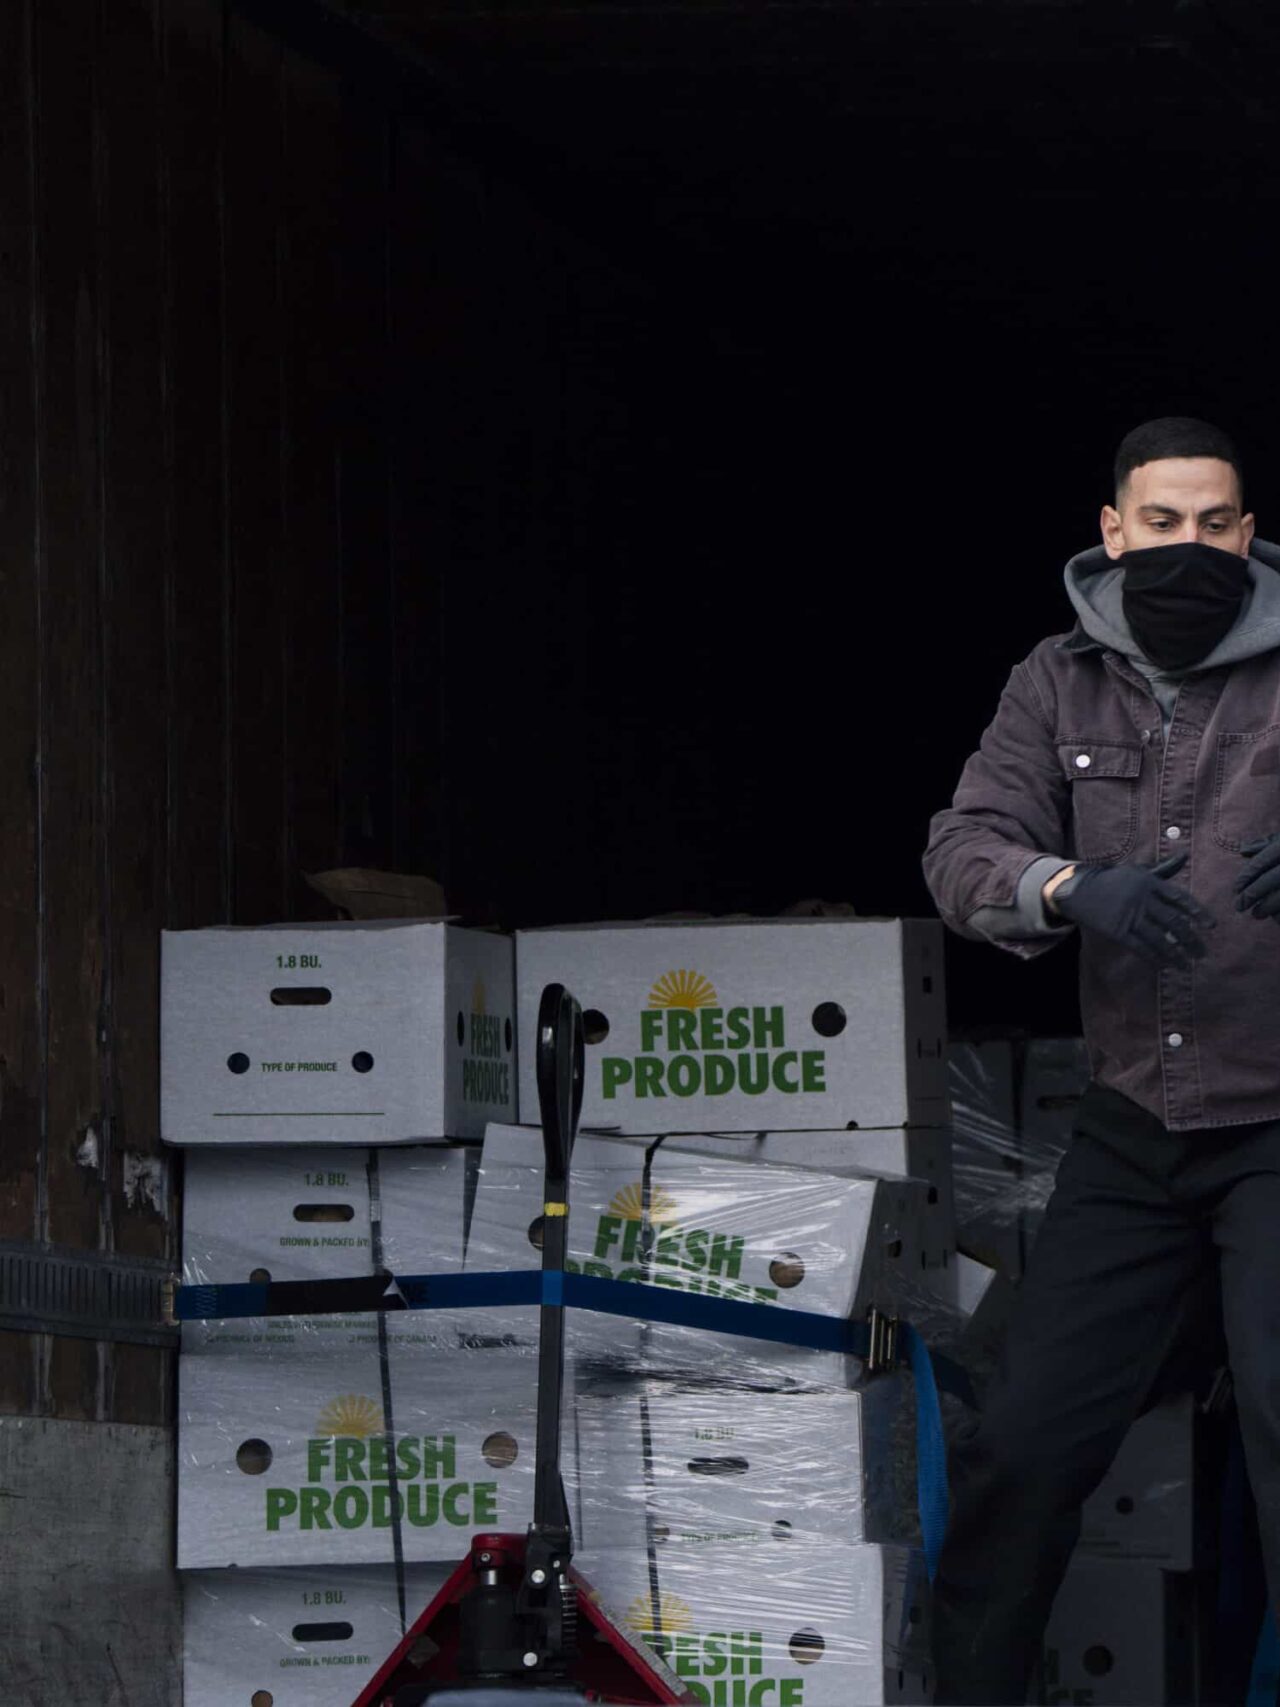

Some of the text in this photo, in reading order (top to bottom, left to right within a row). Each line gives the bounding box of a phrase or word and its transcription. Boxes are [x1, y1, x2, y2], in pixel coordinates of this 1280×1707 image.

[276, 954, 322, 969] 1.8 BU.
[470, 1013, 501, 1059] FRESH
[640, 1005, 784, 1052] FRESH
[261, 1061, 338, 1072] TYPE OF PRODUCE
[463, 1058, 510, 1105] PRODUCE
[602, 1050, 826, 1099] PRODUCE
[304, 1173, 350, 1187] 1.8 BU.
[279, 1236, 311, 1247] GROWN
[321, 1236, 354, 1247] PACKED
[595, 1216, 745, 1279] FRESH
[307, 1436, 456, 1482] FRESH
[266, 1482, 498, 1531] PRODUCE
[302, 1591, 347, 1606] 1.8 BU.
